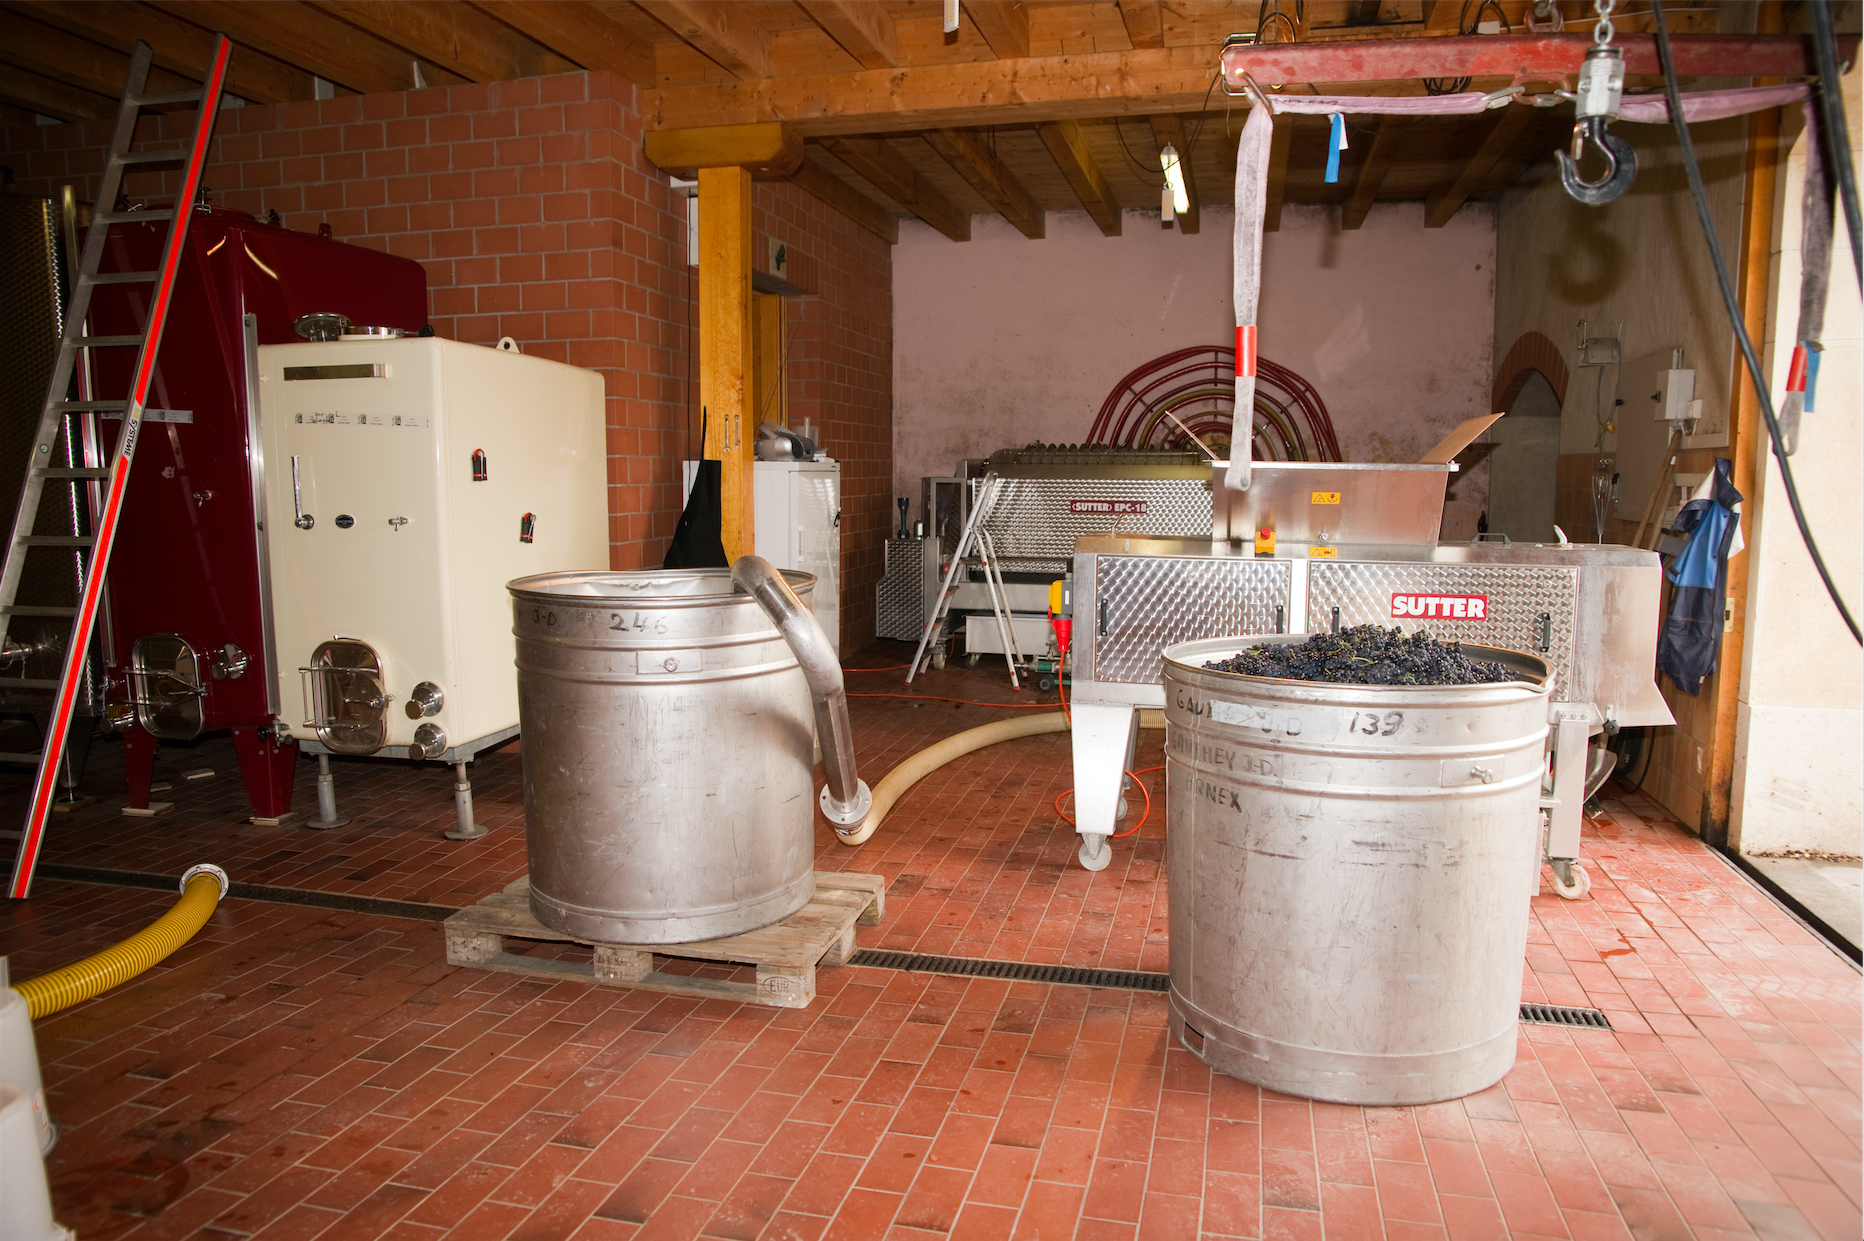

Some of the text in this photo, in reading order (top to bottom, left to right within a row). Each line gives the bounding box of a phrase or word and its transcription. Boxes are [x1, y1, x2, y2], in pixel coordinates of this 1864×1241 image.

[1114, 503, 1147, 512] EPC-18
[1392, 595, 1485, 618] SUTTER
[609, 611, 669, 635] 246
[1349, 710, 1404, 737] 139
